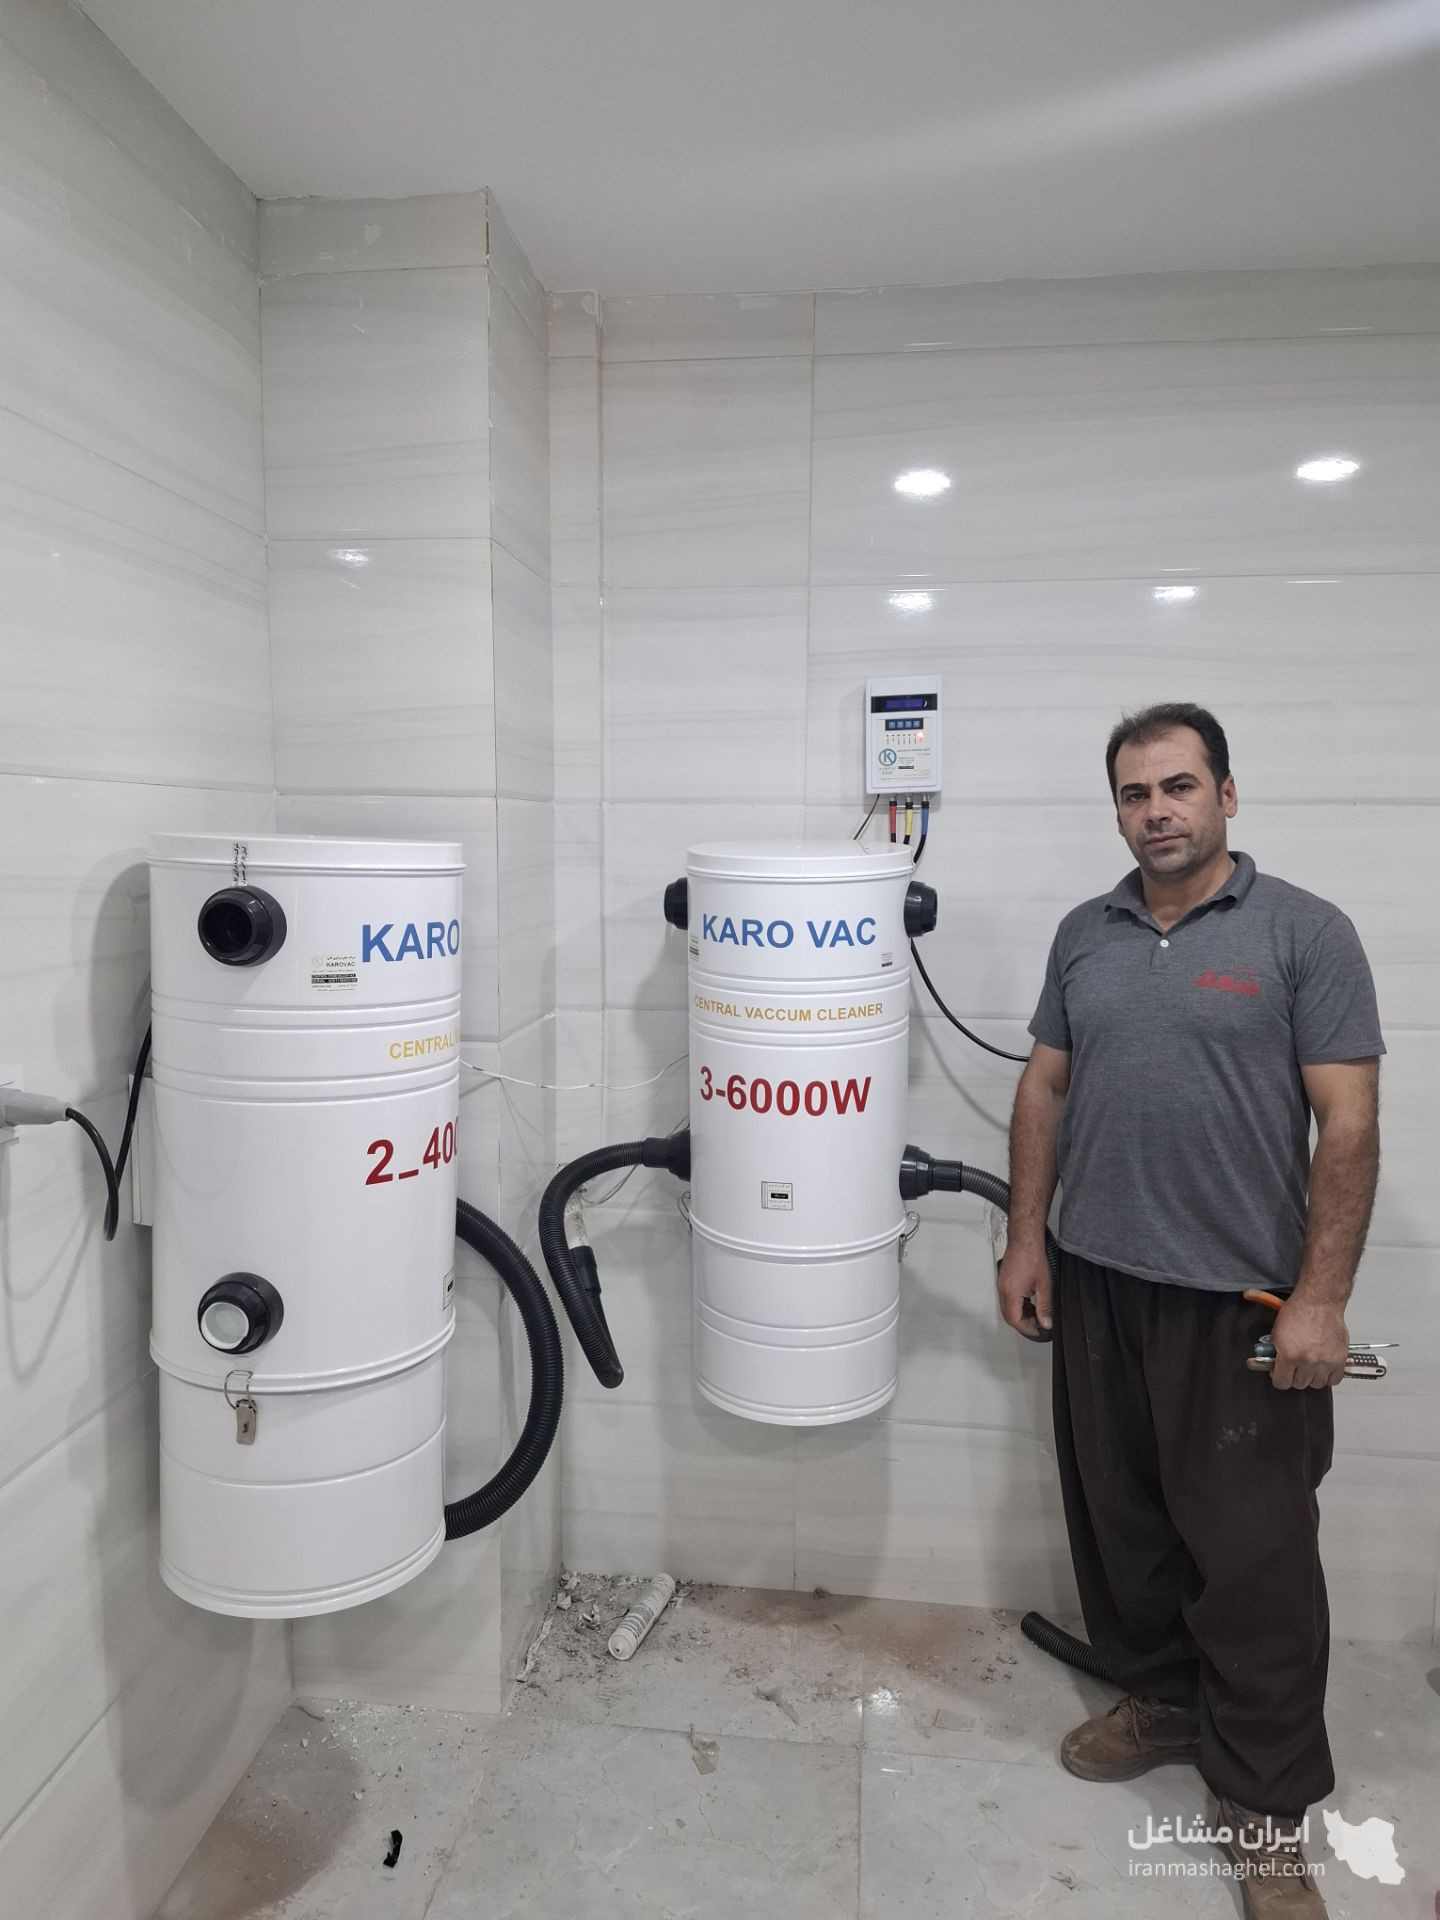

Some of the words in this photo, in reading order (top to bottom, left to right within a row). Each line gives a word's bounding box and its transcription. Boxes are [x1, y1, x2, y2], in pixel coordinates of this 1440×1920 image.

[362, 919, 460, 963] KARO
[703, 914, 794, 948] KARO
[807, 917, 876, 948] VAC
[695, 995, 740, 1017] CENTRAL
[745, 1006, 811, 1021] VACCUM
[817, 1002, 883, 1021] CLEANER
[389, 1032, 454, 1059] CENTRAL
[700, 1065, 872, 1117] 3-6000W
